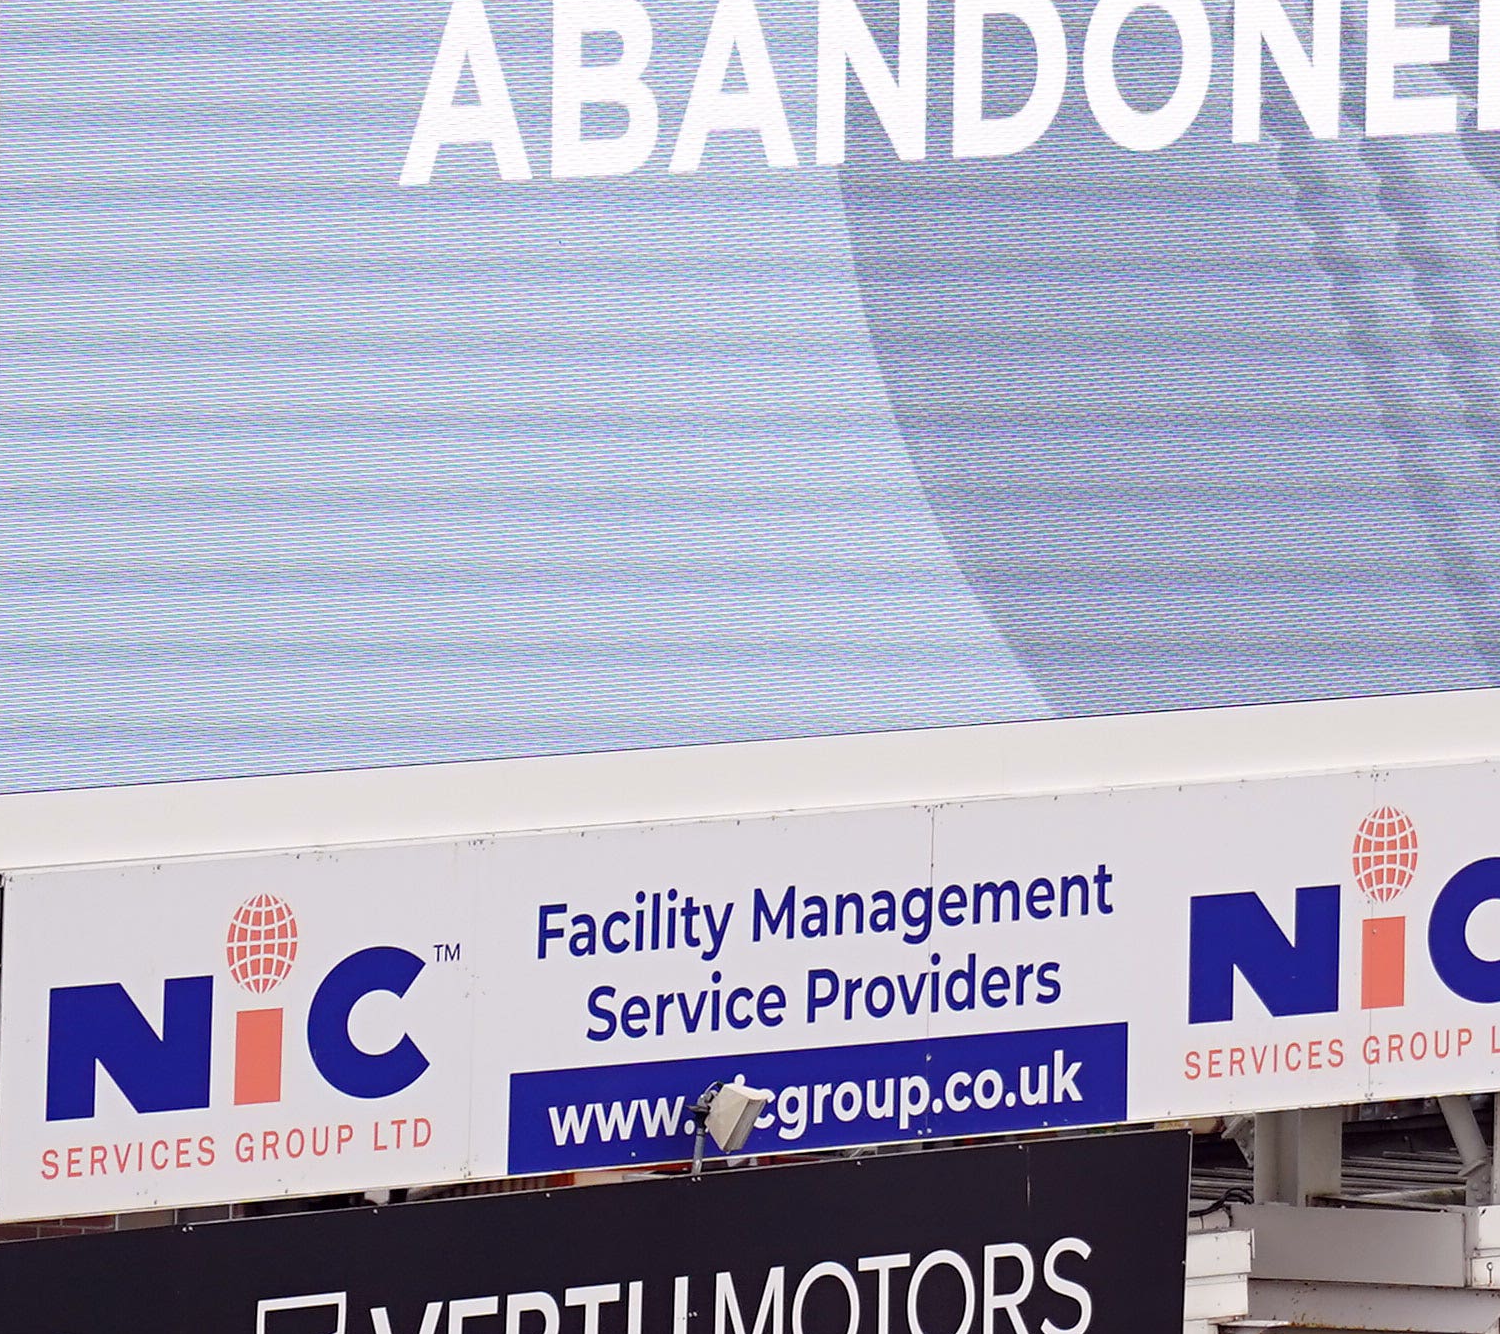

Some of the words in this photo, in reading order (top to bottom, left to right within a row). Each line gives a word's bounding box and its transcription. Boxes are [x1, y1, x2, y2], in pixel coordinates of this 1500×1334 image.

[538, 889, 734, 961] Facility
[753, 865, 1113, 945] Management
[586, 979, 784, 1044] Service
[807, 953, 1062, 1028] Providers
[549, 1050, 1083, 1146] www.cgroup.co.uk
[1185, 1039, 1343, 1080] SERVICES
[1363, 1028, 1472, 1065] GROUP
[41, 1136, 214, 1179] SERVICES
[236, 1125, 353, 1162] GROUP
[374, 1118, 431, 1150] LTD
